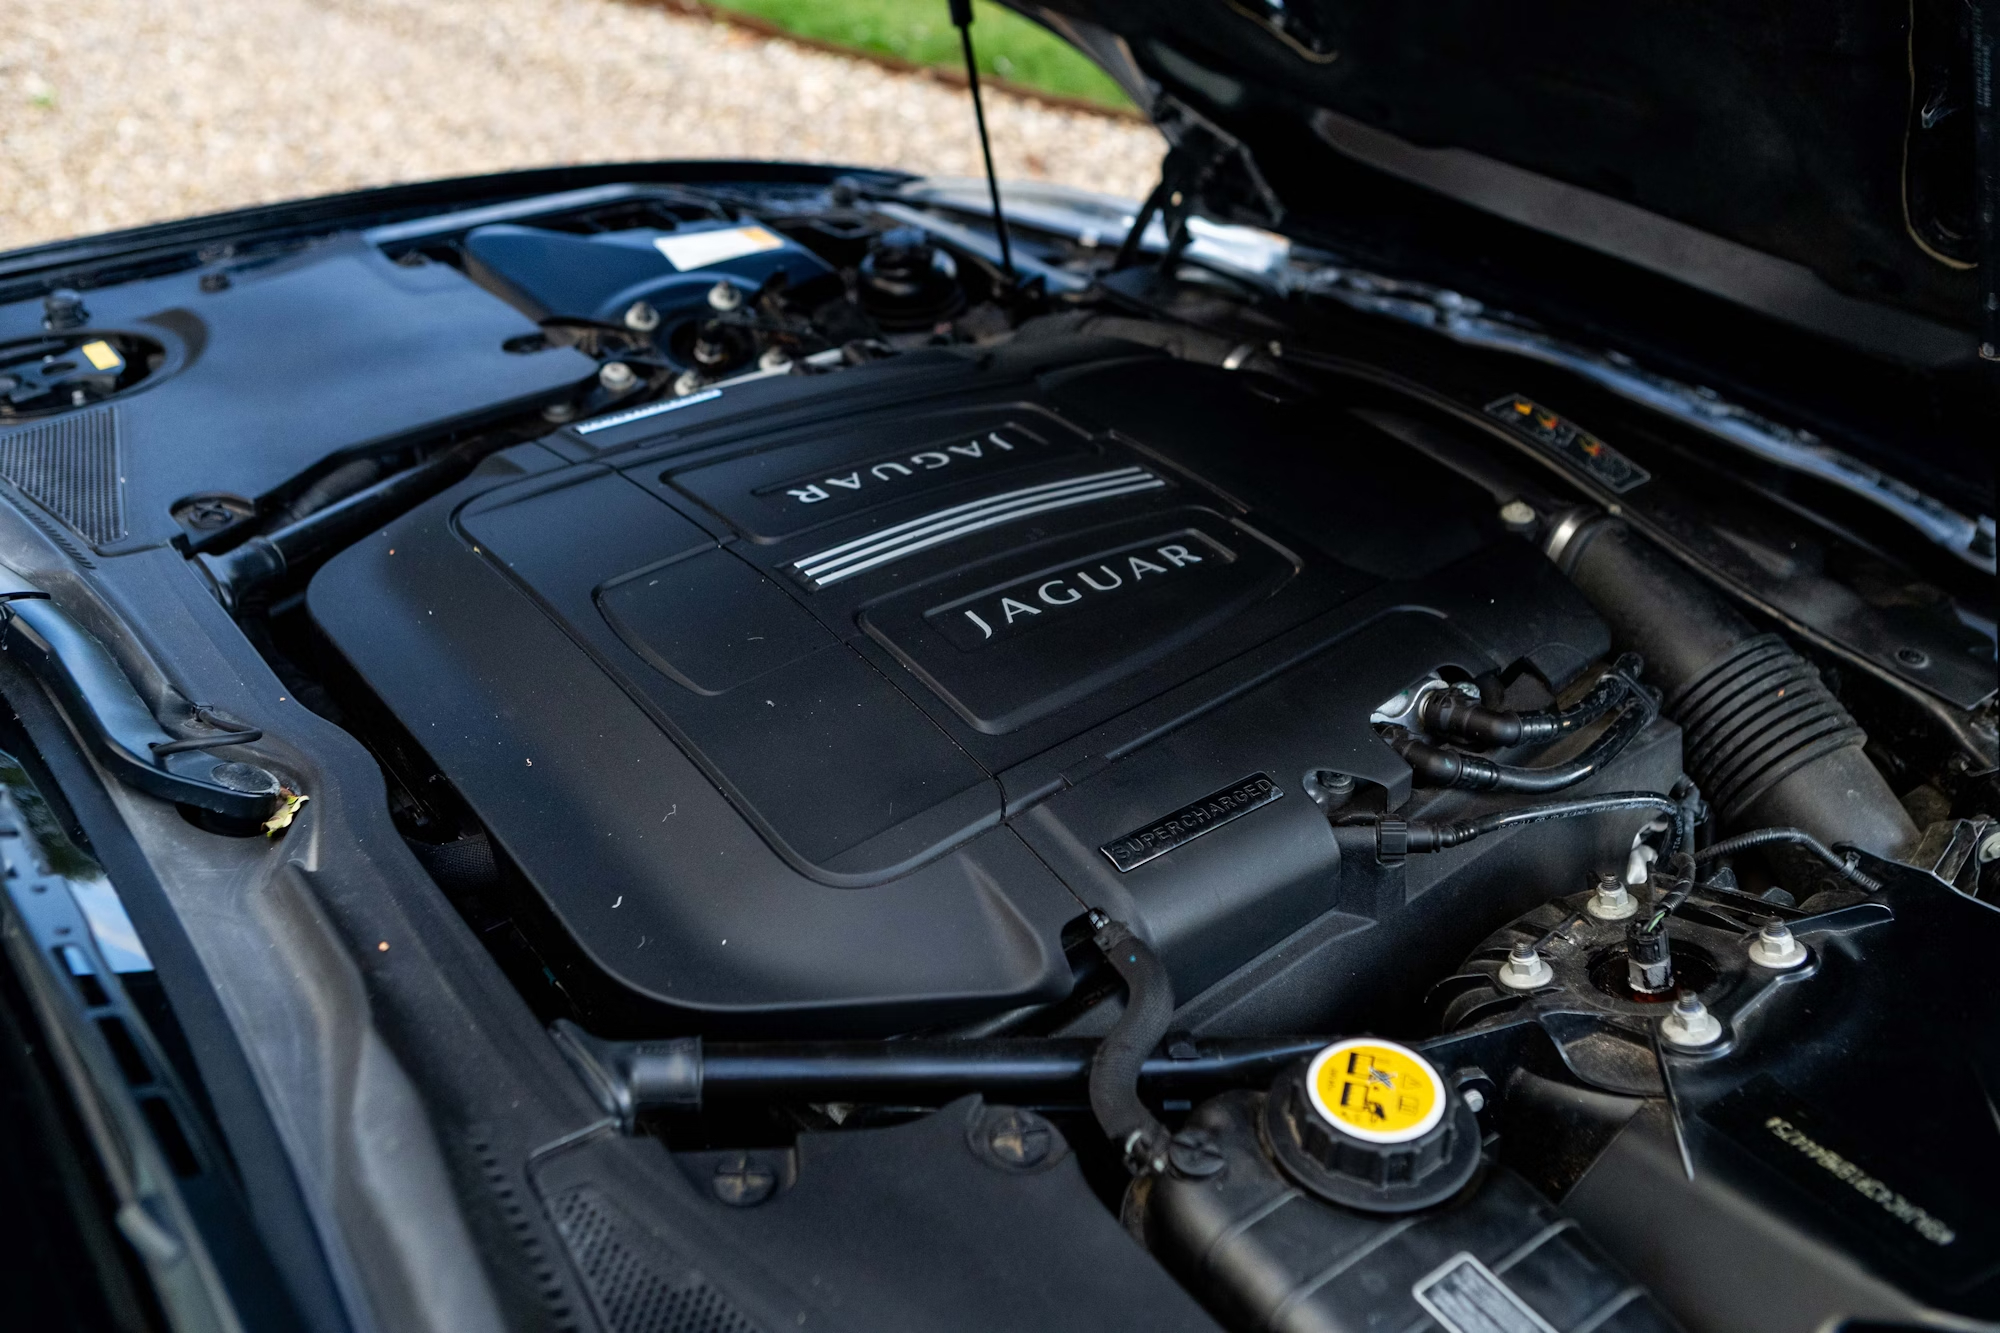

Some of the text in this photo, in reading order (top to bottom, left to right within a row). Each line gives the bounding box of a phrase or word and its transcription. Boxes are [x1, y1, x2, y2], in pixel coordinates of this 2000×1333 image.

[787, 432, 1014, 503] JAGUAR
[964, 545, 1202, 639] JAGUAR
[1111, 778, 1274, 860] SUPERCHARGED
